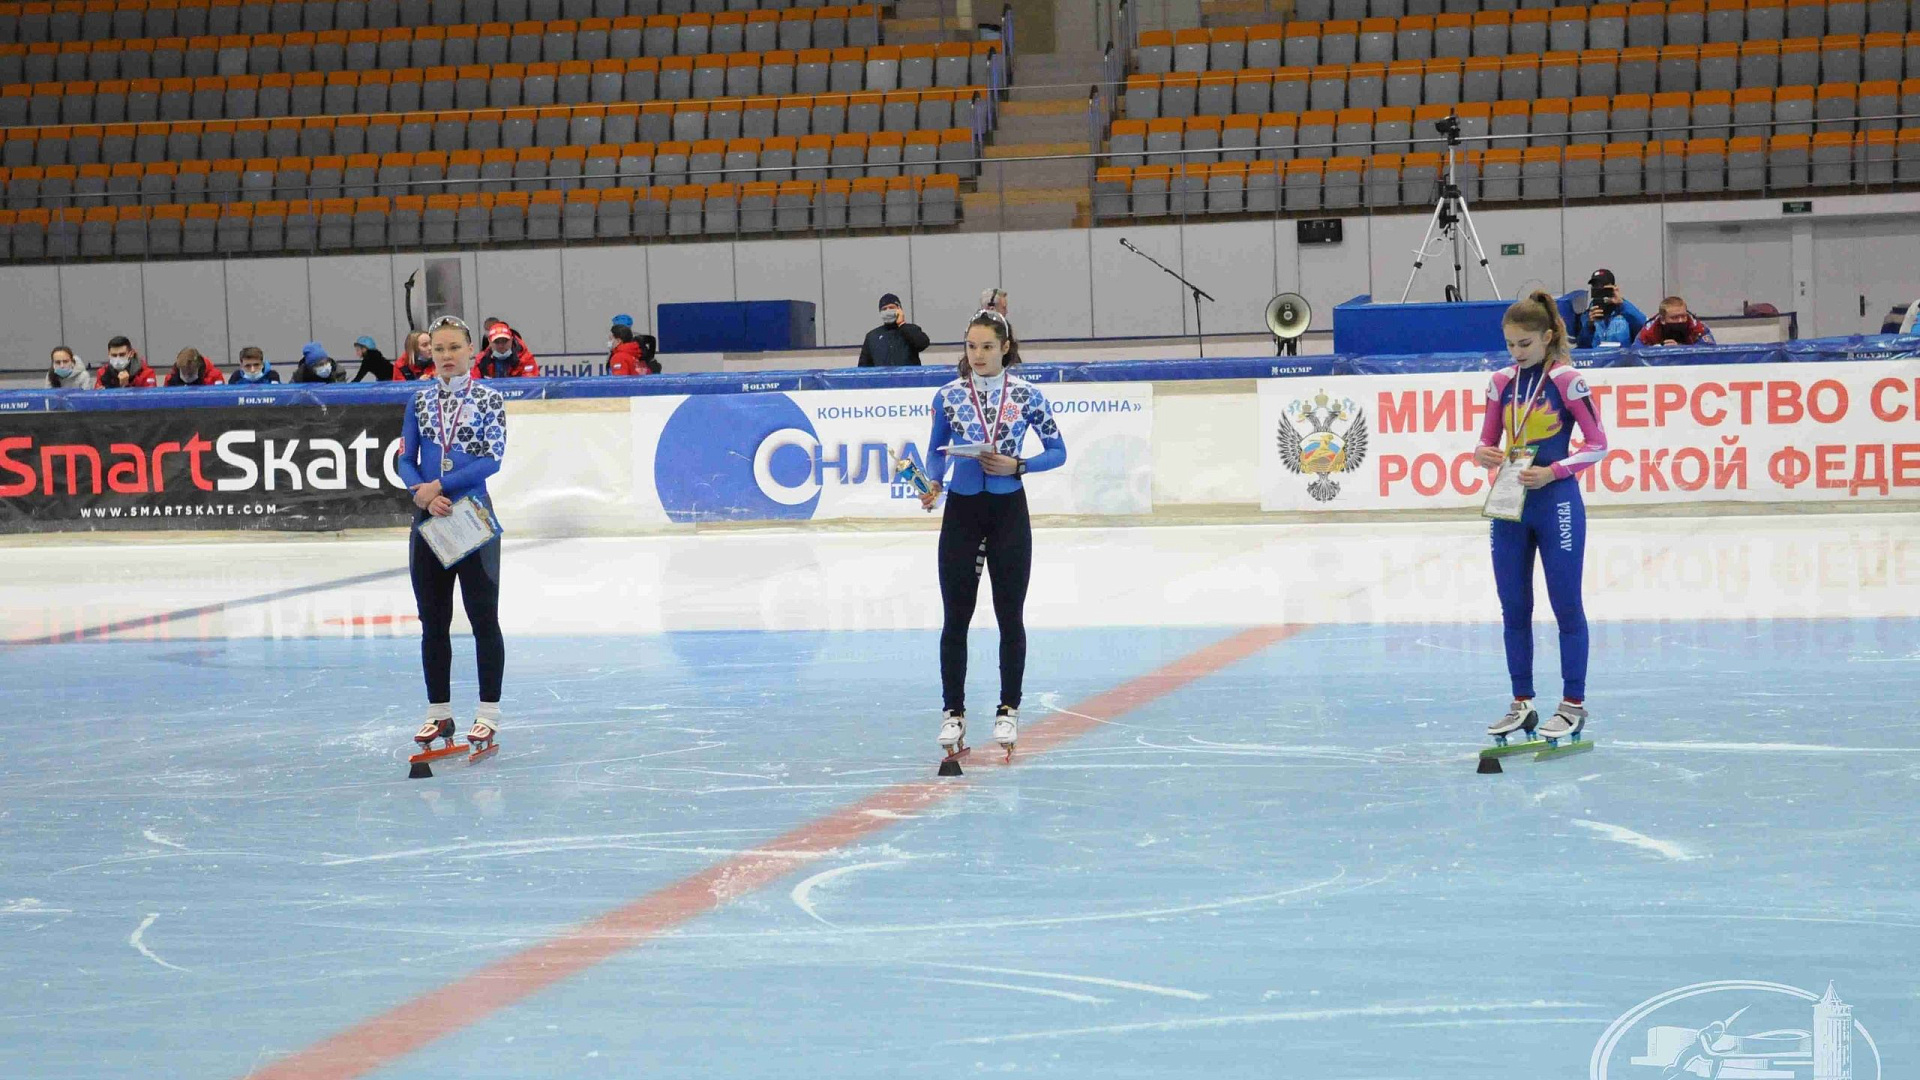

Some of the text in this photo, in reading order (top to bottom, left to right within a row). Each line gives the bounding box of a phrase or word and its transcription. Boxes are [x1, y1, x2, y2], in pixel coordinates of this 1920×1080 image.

[539, 360, 592, 377] НЫЙ
[1280, 366, 1312, 374] OLYMP
[750, 382, 780, 390] OLYMP
[0, 401, 29, 410] OLYMP
[1870, 377, 1920, 423] С
[817, 400, 1142, 419] КОНЬКОБЕЖН ОЛОМНА»
[754, 428, 930, 505] ОНЛА
[80, 504, 277, 518] WWW.SMARTSKATE.COM
[1557, 500, 1572, 551] МОСКВА
